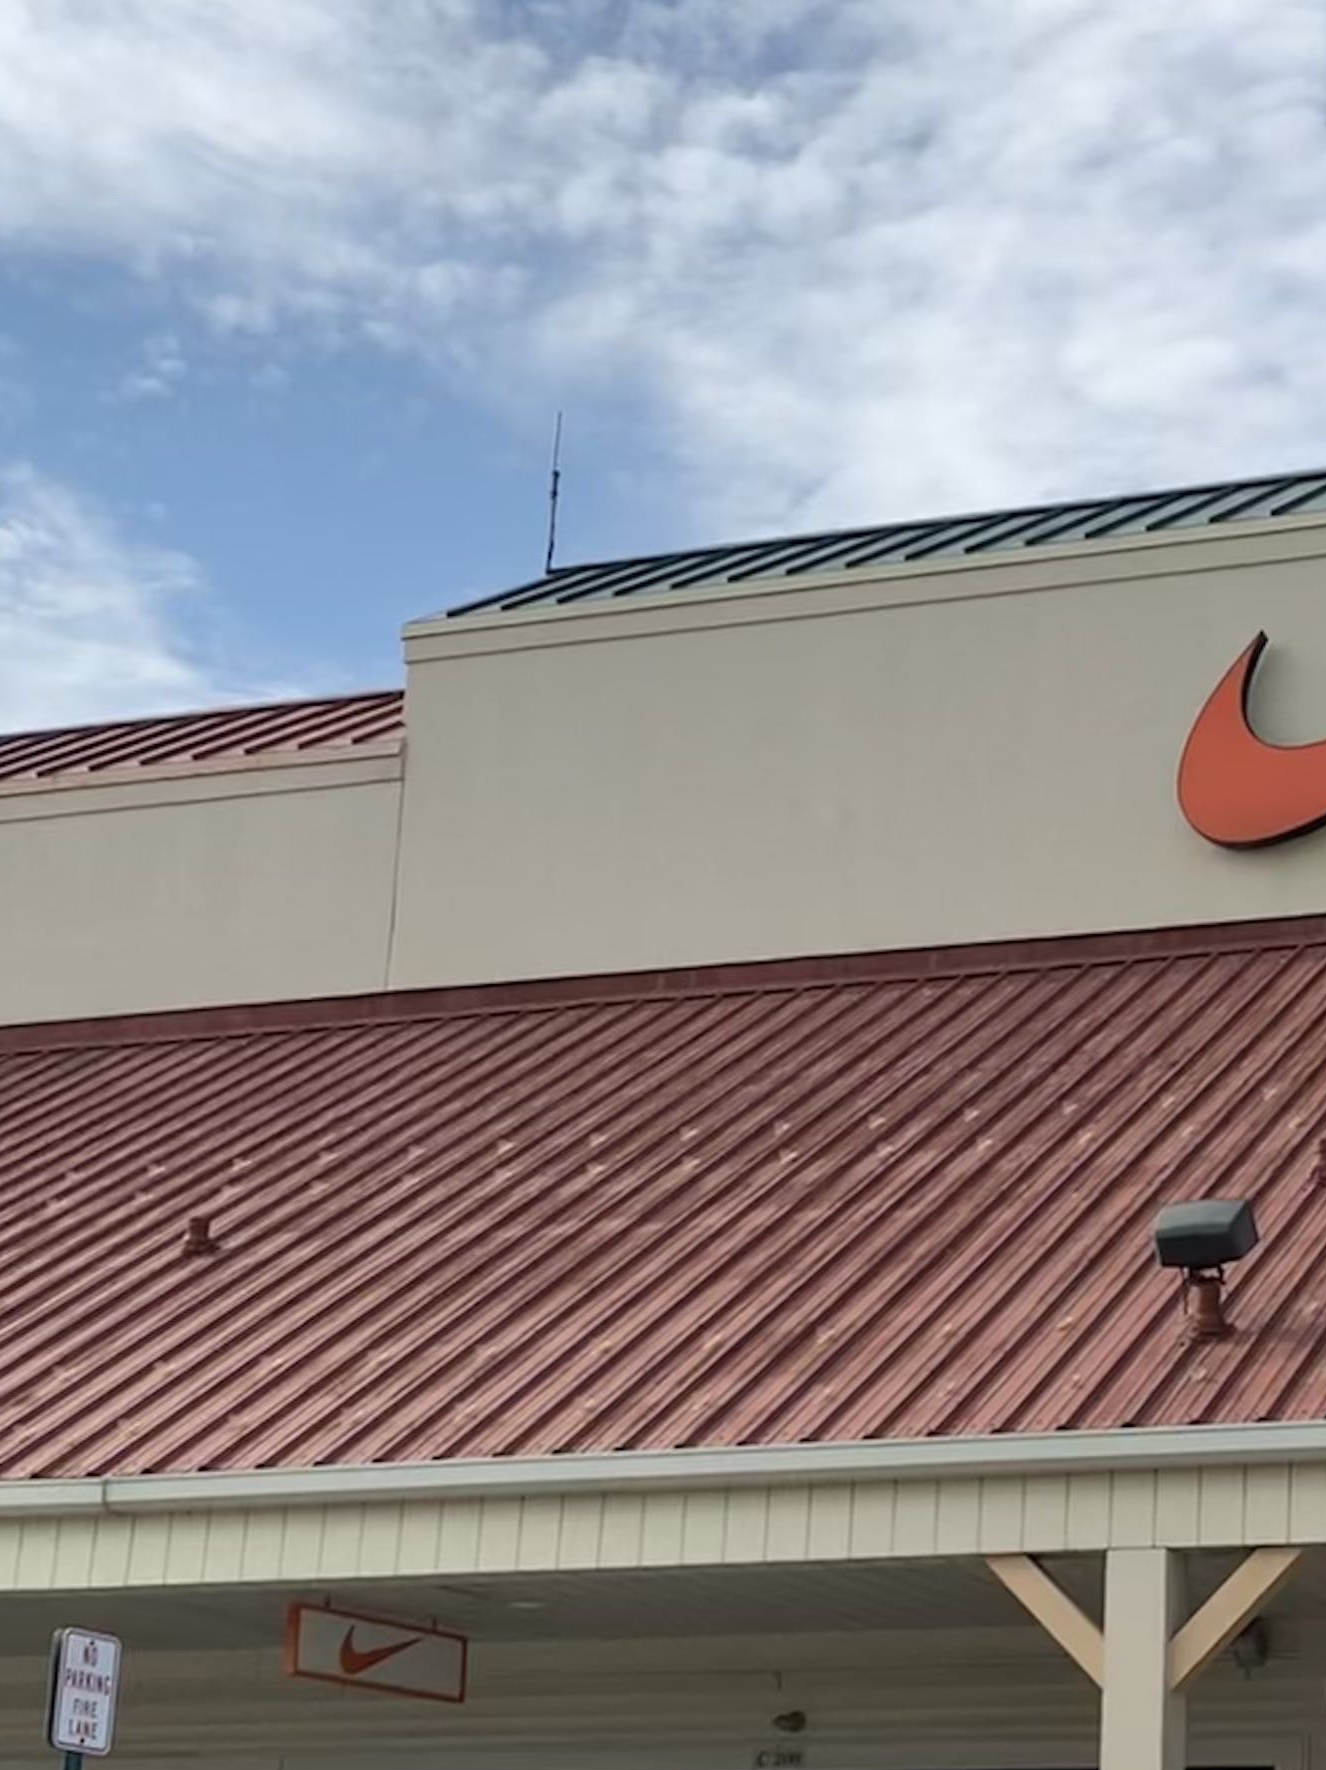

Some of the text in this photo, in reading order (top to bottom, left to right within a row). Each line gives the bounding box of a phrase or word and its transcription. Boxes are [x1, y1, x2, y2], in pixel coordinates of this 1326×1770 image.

[83, 1645, 98, 1668] NO
[65, 1667, 110, 1697] PARKING
[73, 1698, 97, 1719] FIRE
[68, 1719, 97, 1740] LANE
